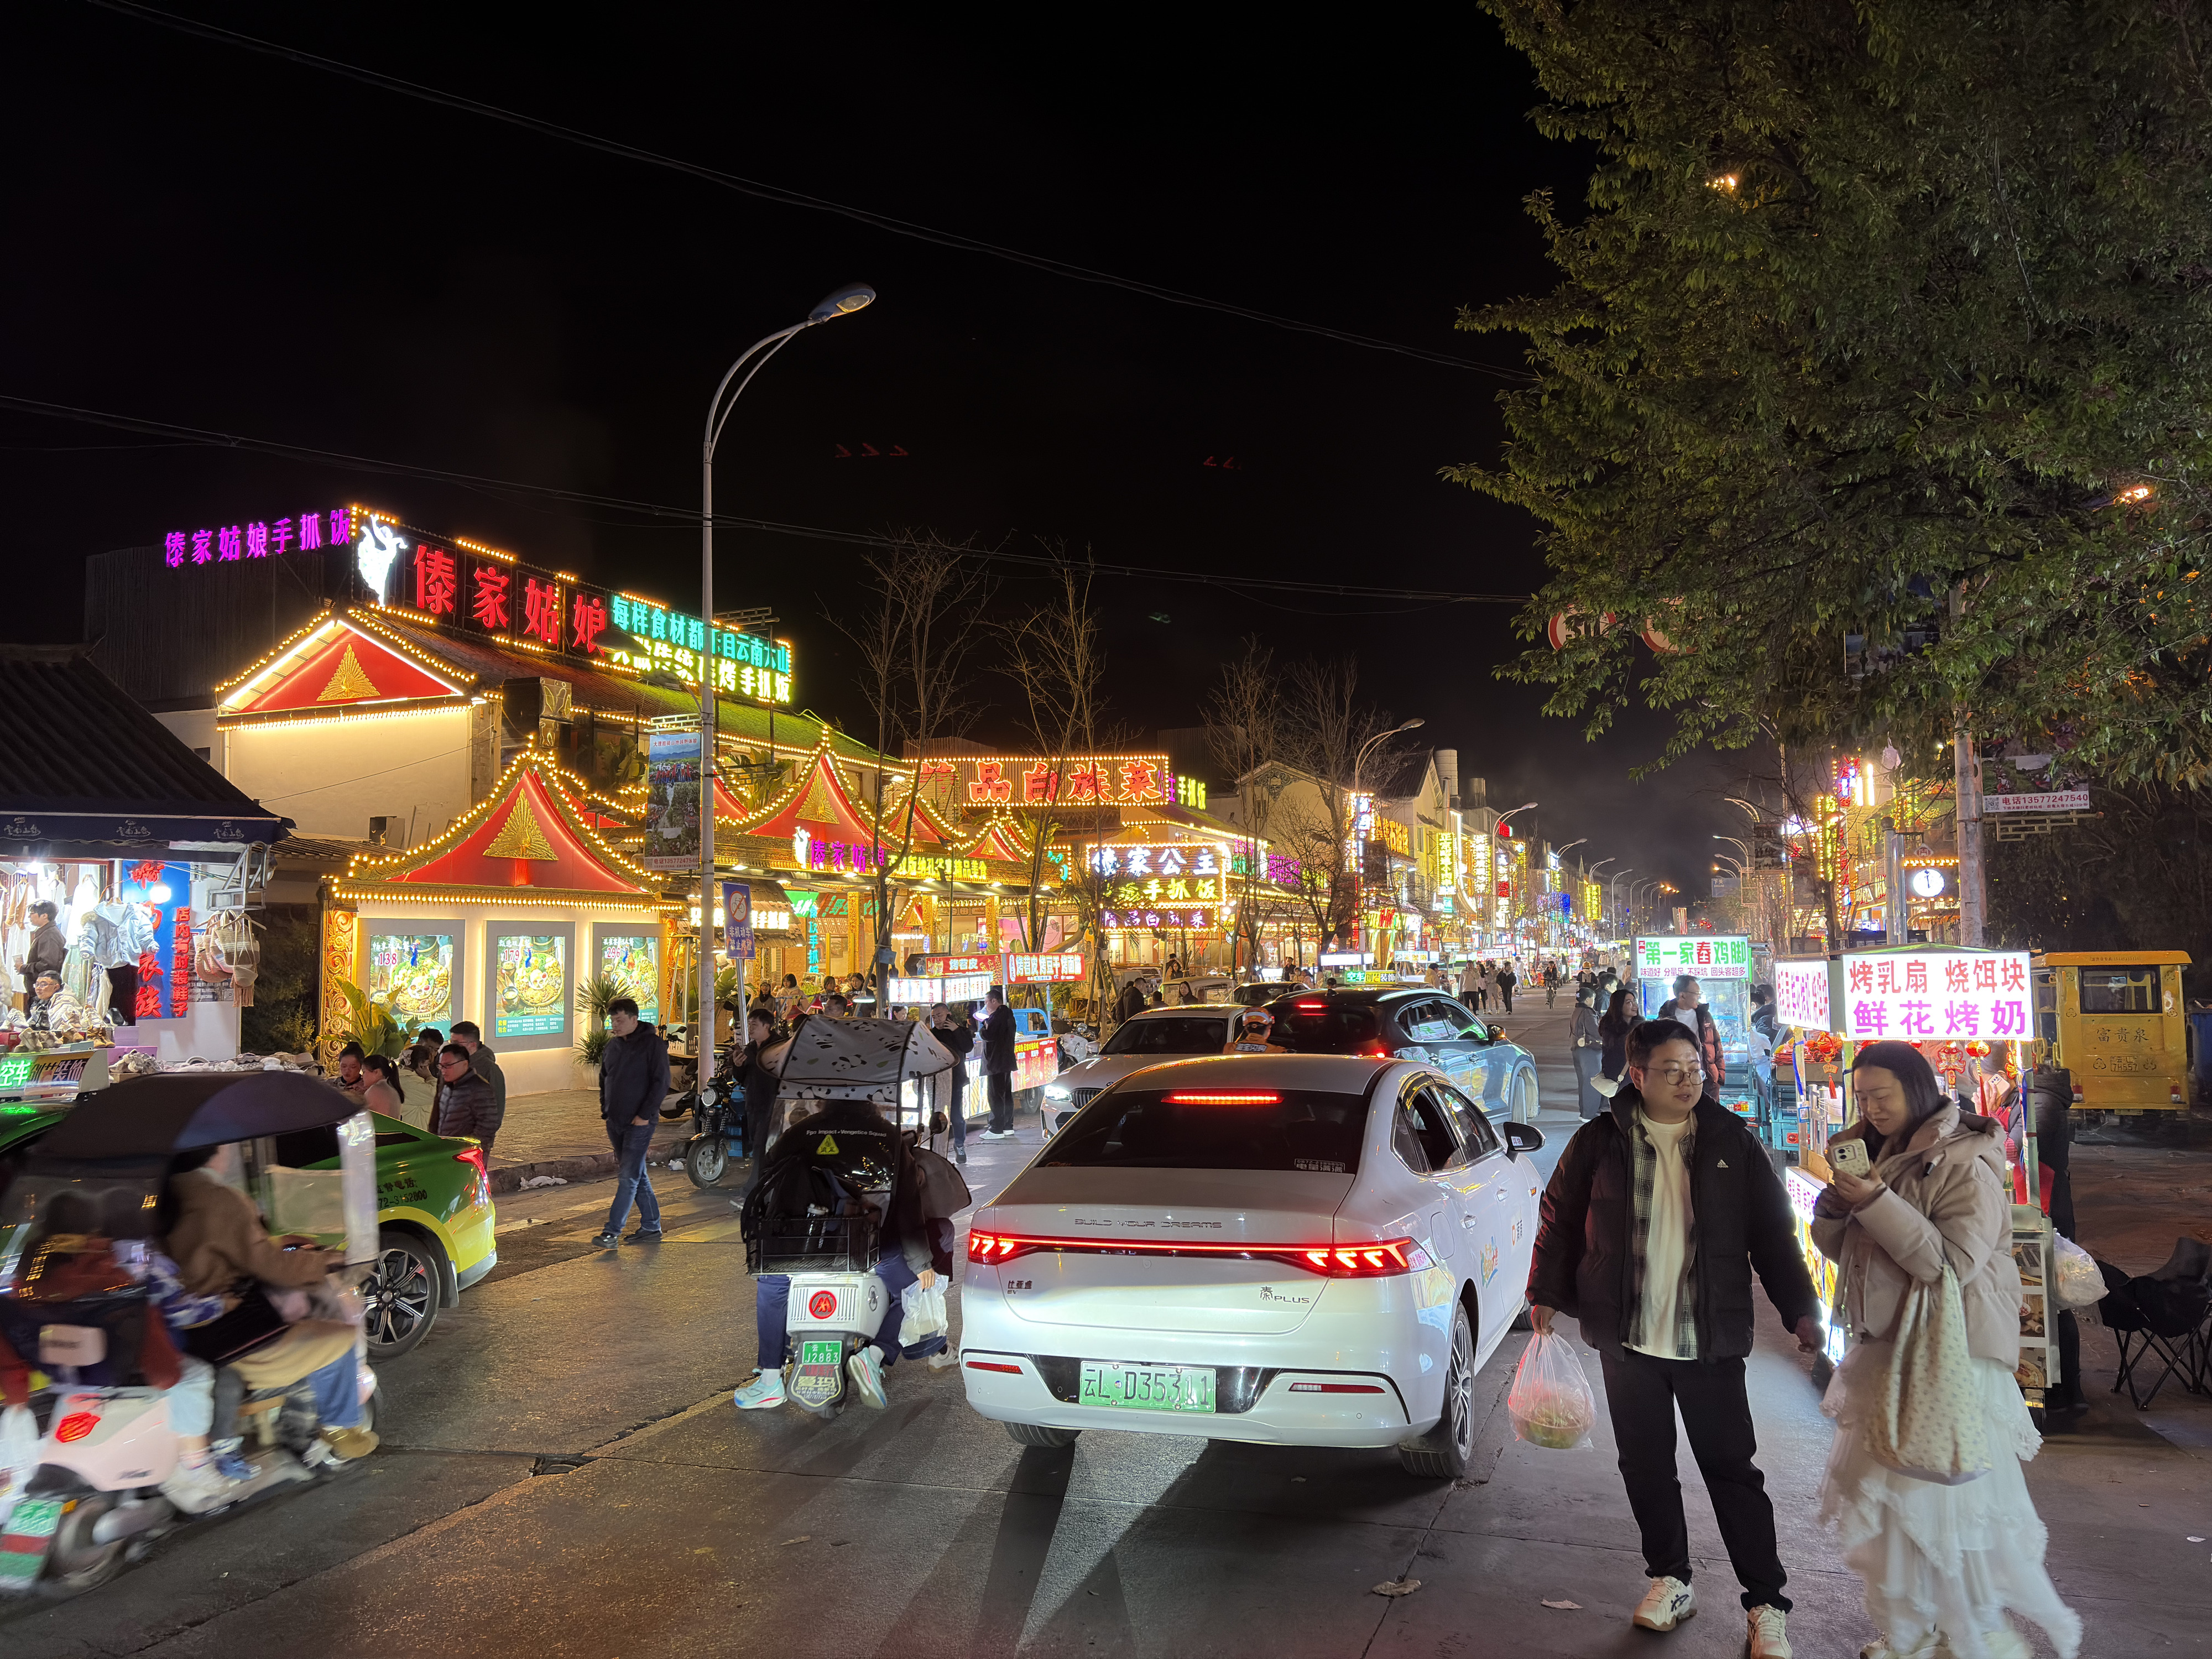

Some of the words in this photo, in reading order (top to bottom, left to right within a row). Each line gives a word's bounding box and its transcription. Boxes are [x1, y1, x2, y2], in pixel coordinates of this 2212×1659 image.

[165, 508, 351, 568] 傣家姑娘手抓饭
[414, 545, 607, 658] 傣家姑娘
[2002, 794, 2088, 806] 电话13577247540
[1091, 847, 1220, 875] 傣家公主
[729, 926, 751, 937] 非机动车
[730, 939, 753, 951] 禁止停放
[1639, 941, 1645, 953] 正宗
[1646, 941, 1746, 965] 第一家舂鸡脚
[173, 907, 190, 1018] 店内有时装鞋子
[1640, 968, 1661, 977] 味道好
[1664, 968, 1684, 977] 分量足
[1688, 968, 1708, 977] 不踩坑
[1711, 967, 1746, 977] 回头客超多
[1347, 972, 1364, 982] 空车
[1366, 973, 1395, 983] 创艺装饰
[1849, 960, 1929, 995] 烤乳扇
[1945, 958, 2026, 994] 烧饵块
[1854, 1000, 2026, 1037] 鲜花烤奶
[2097, 1027, 2149, 1043] 富贵泉
[0, 1060, 31, 1086] 空车
[804, 1352, 838, 1363] J2883
